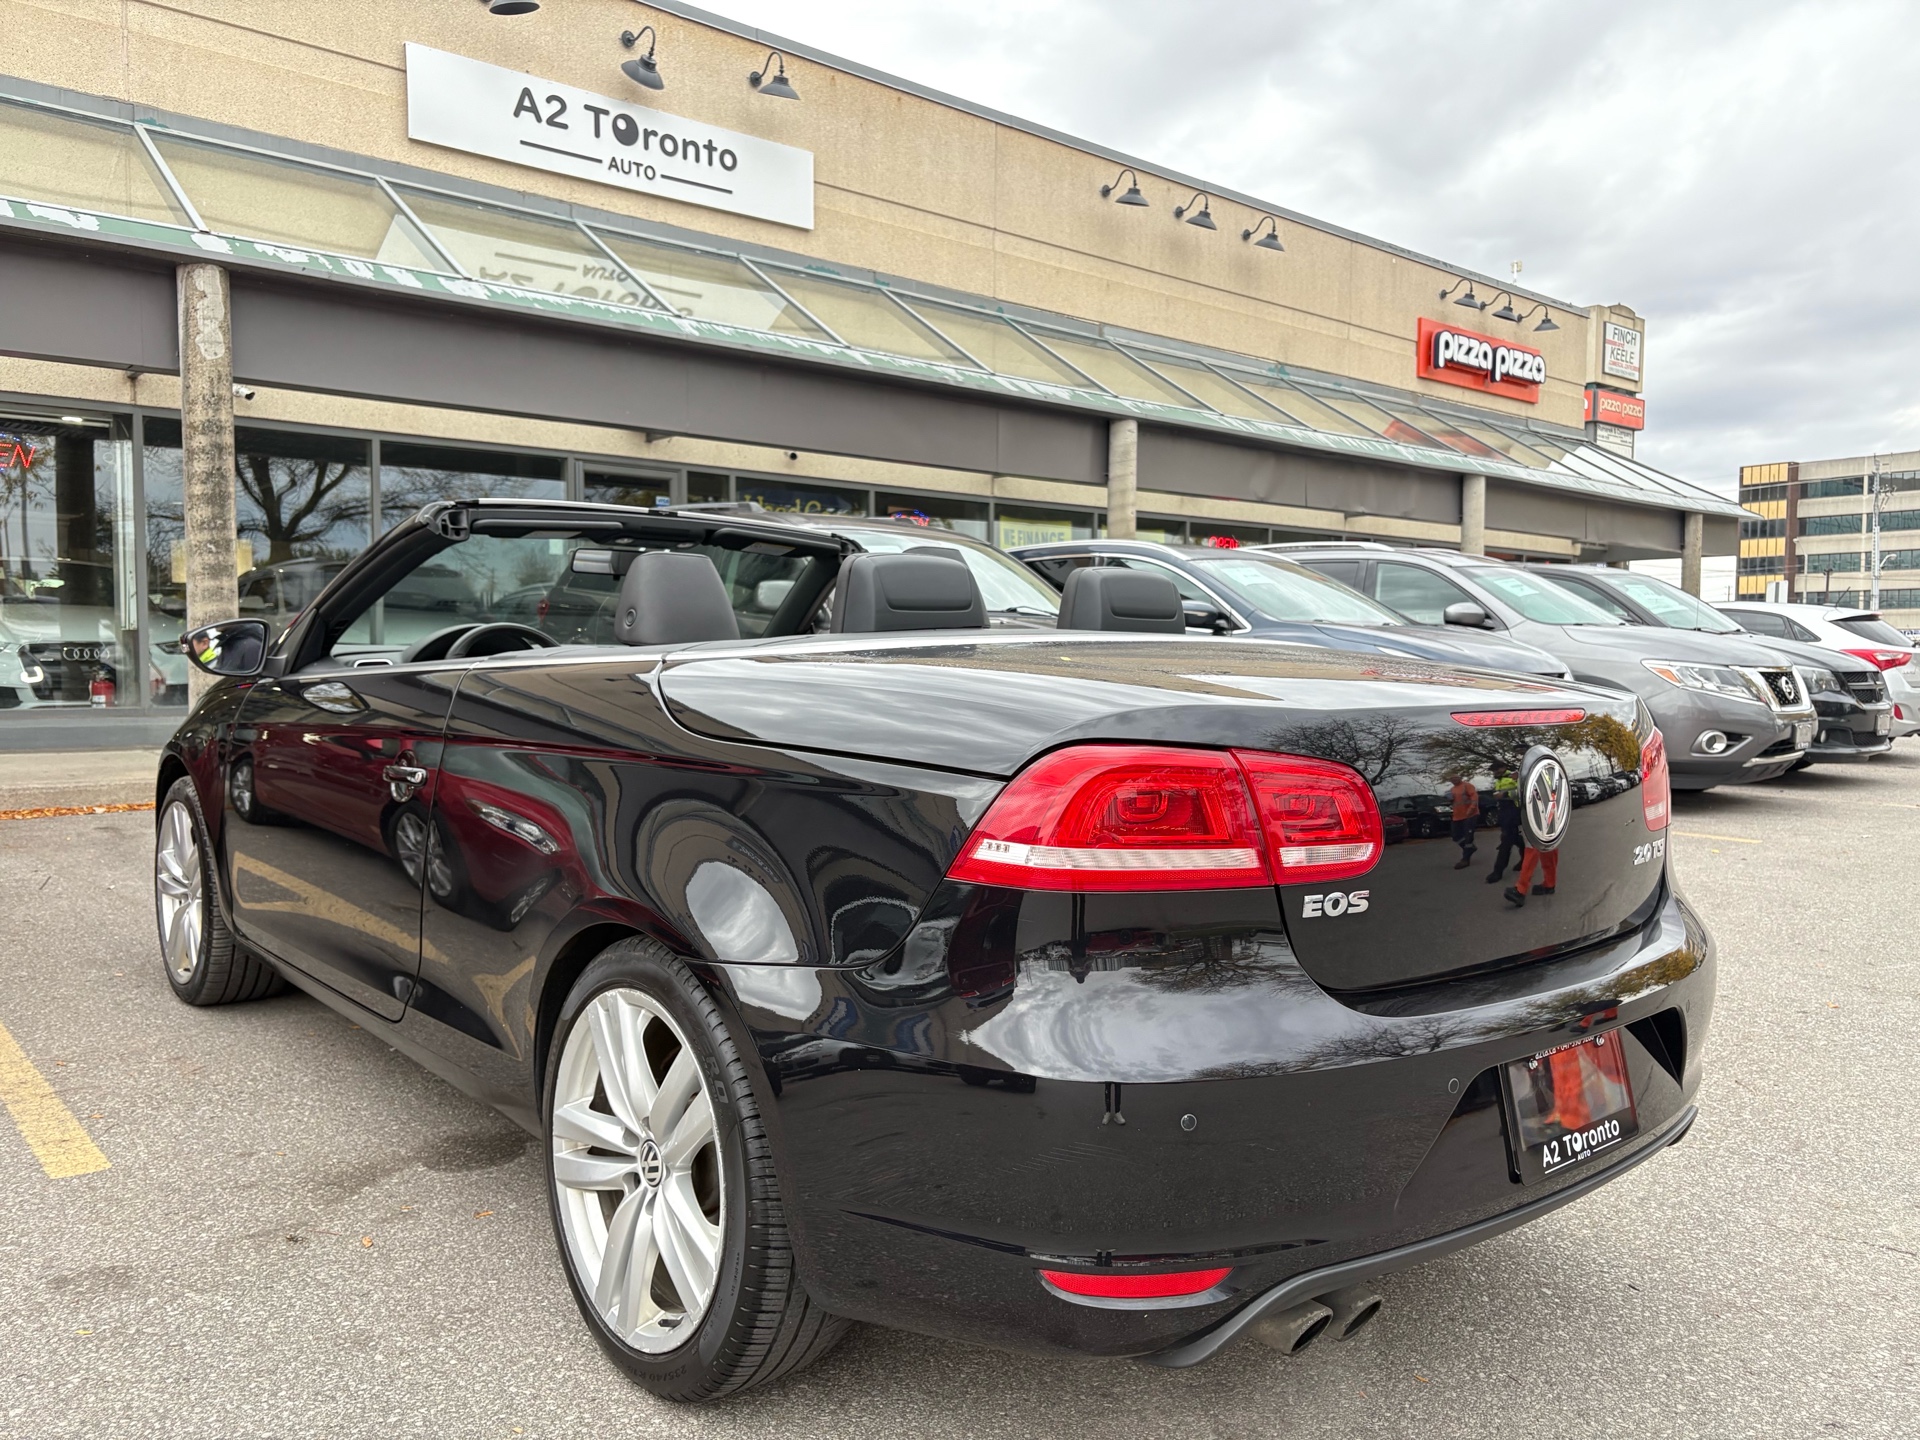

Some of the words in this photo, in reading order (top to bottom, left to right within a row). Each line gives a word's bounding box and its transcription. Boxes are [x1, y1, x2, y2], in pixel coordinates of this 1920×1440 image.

[513, 86, 569, 131] A2
[607, 156, 657, 181] AUTO
[1612, 327, 1637, 346] FINCH
[1437, 330, 1493, 370] pizza
[1494, 346, 1546, 384] pizza
[1609, 346, 1635, 365] KEELE
[1600, 398, 1621, 414] pizza
[1622, 403, 1643, 418] pizza
[1017, 529, 1065, 546] FINANCE
[1208, 535, 1238, 550] OPEN
[1302, 889, 1370, 918] EOS
[1543, 1140, 1561, 1168] A2
[1577, 1150, 1591, 1161] AUTO
